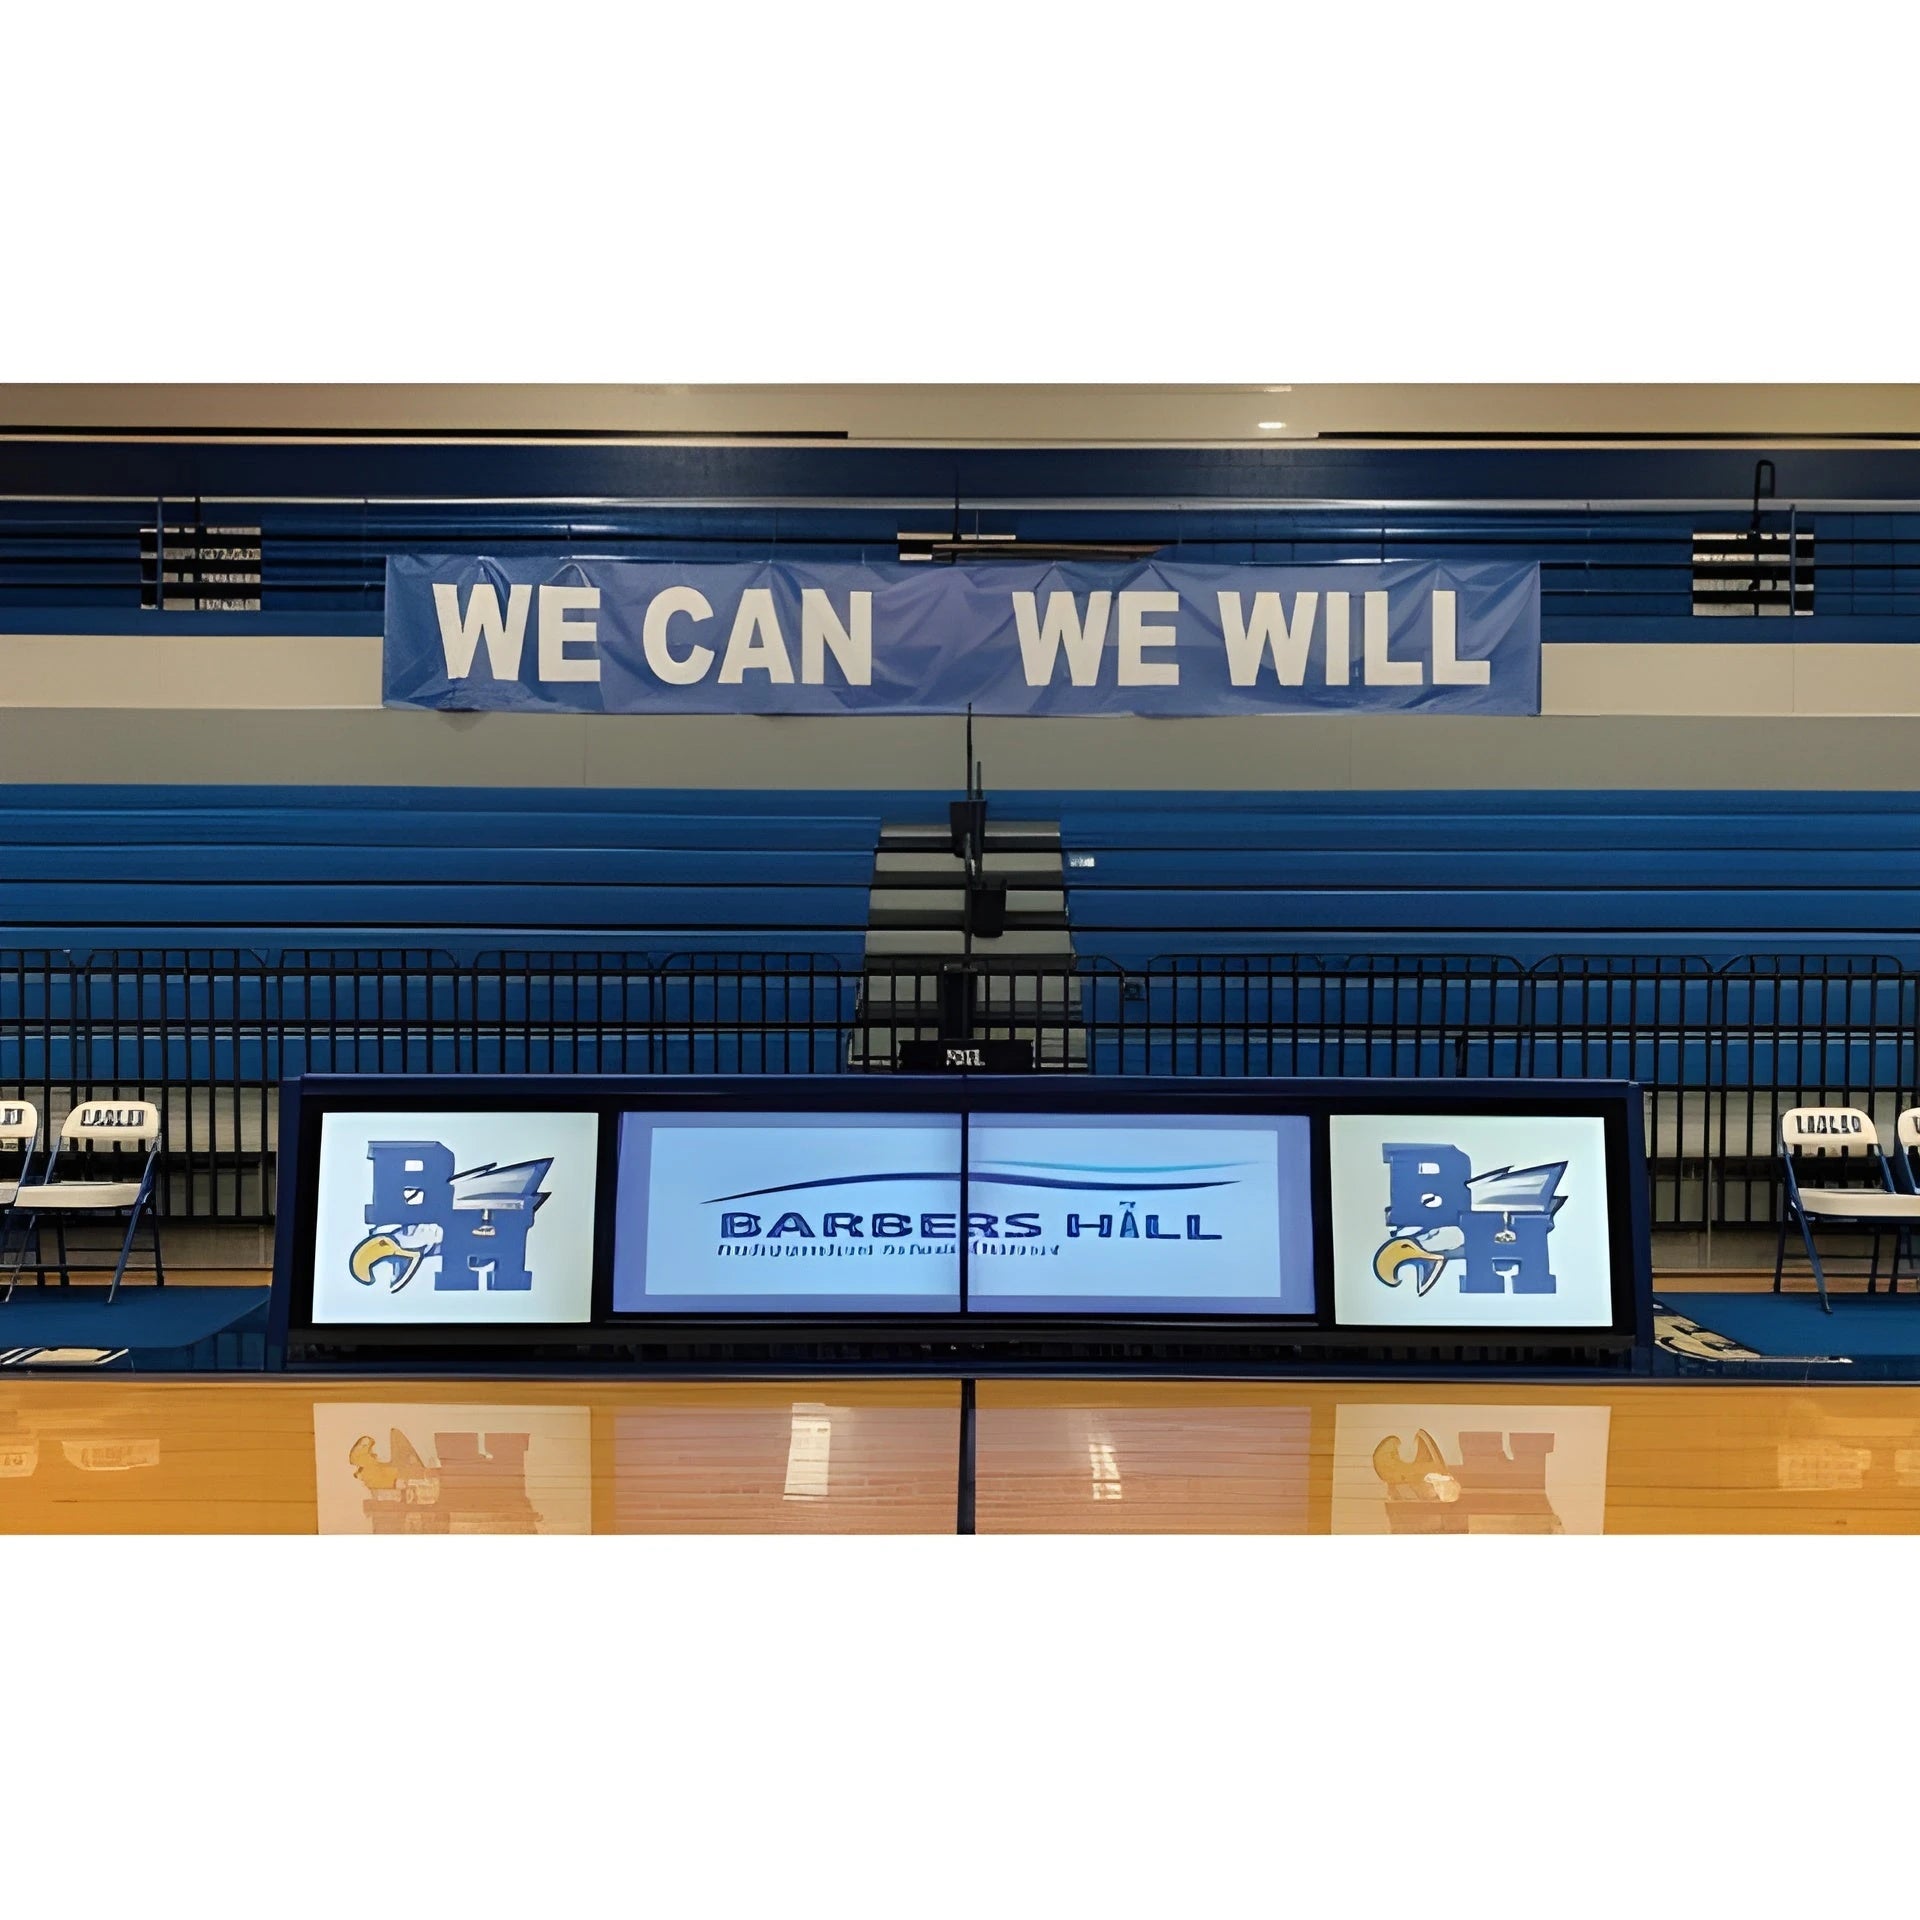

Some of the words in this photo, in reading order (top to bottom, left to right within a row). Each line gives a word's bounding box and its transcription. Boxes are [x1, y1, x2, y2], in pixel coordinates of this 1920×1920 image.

[431, 583, 602, 683] WE
[642, 586, 873, 687] CAN
[1012, 590, 1180, 687] WE
[1216, 589, 1491, 687] WILL
[720, 1211, 1042, 1239] BARBERS
